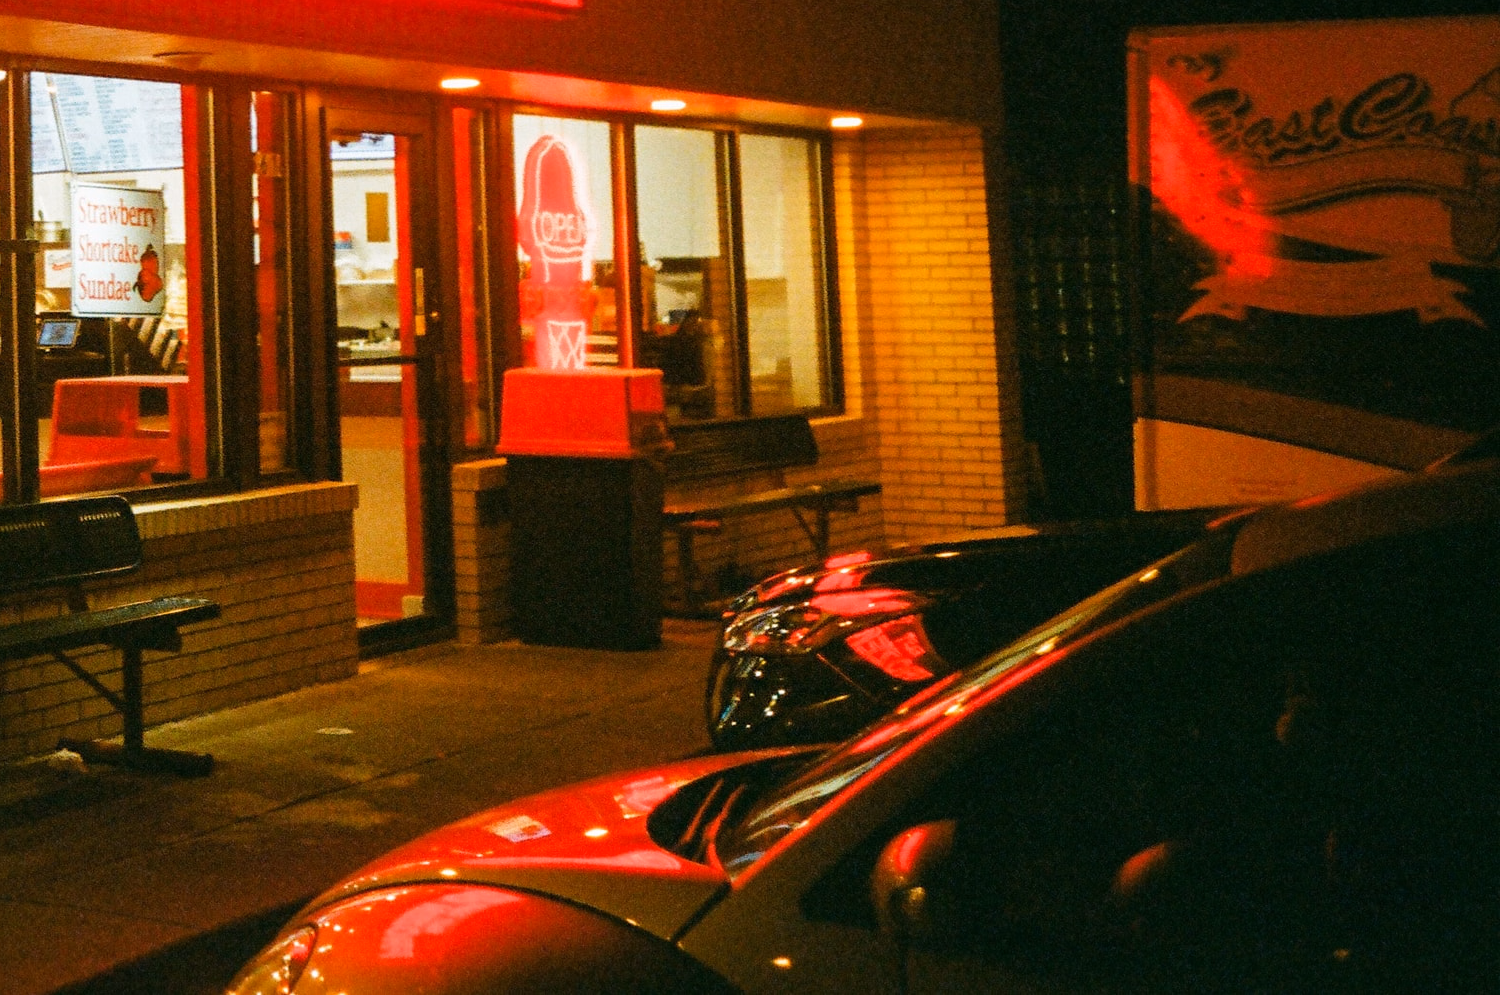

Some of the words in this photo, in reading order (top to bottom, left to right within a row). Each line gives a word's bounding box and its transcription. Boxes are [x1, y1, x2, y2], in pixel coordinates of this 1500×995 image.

[79, 197, 159, 235] Strawberry
[79, 234, 140, 264] Shortcake
[79, 273, 131, 301] Sundae
